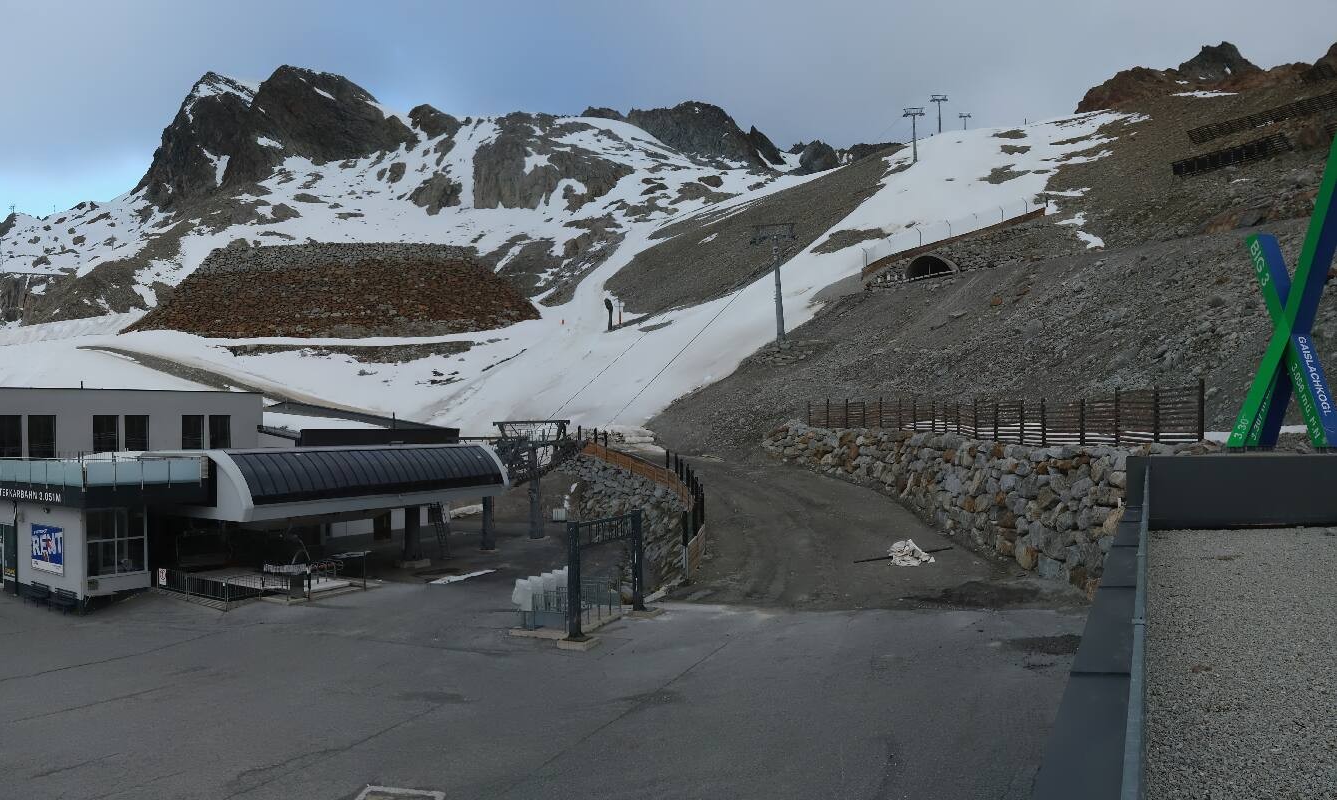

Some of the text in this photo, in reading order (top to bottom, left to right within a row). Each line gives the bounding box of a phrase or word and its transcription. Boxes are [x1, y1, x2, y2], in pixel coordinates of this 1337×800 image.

[1250, 239, 1270, 287] BIG 3
[1298, 336, 1332, 417] GAISLACHKOGL
[31, 532, 63, 556] RENT
